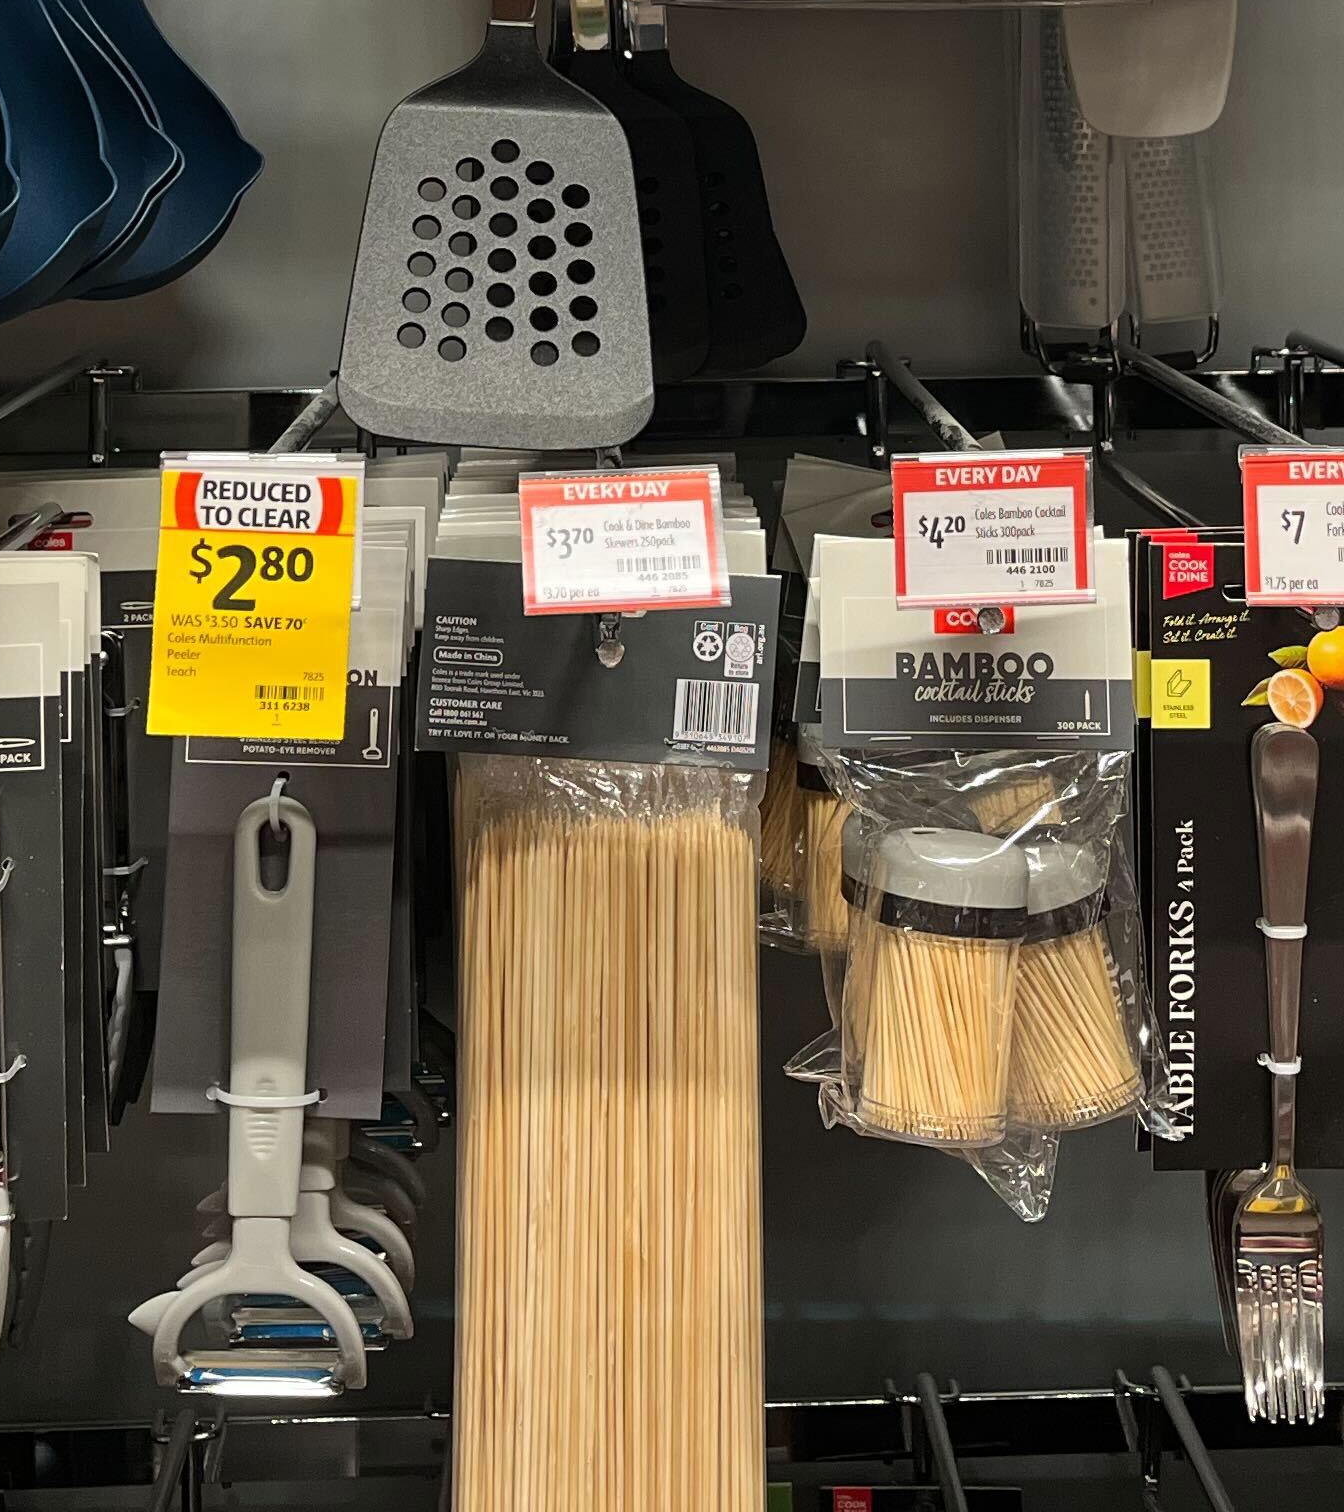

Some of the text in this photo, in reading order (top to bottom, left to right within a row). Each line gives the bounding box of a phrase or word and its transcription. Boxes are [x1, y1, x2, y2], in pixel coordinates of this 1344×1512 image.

[935, 465, 1041, 485] EVERY DAY
[203, 480, 311, 503] REDUCED
[563, 481, 671, 501] EVERY DAY
[200, 506, 311, 529] TO CLEAR
[1281, 509, 1305, 544] $7
[1168, 559, 1207, 571] COOK
[436, 615, 477, 626] CAUTION
[896, 652, 1054, 680] BAMBOO
[914, 680, 1036, 703] cocktail sticks
[929, 715, 1022, 724] INCLUDES DISPENSER
[1056, 721, 1101, 730] 300 PACK
[0, 752, 31, 764] PACK
[1175, 819, 1194, 875] Pack
[1168, 900, 1196, 1022] FORKS
[1168, 1029, 1195, 1136] TABLE
